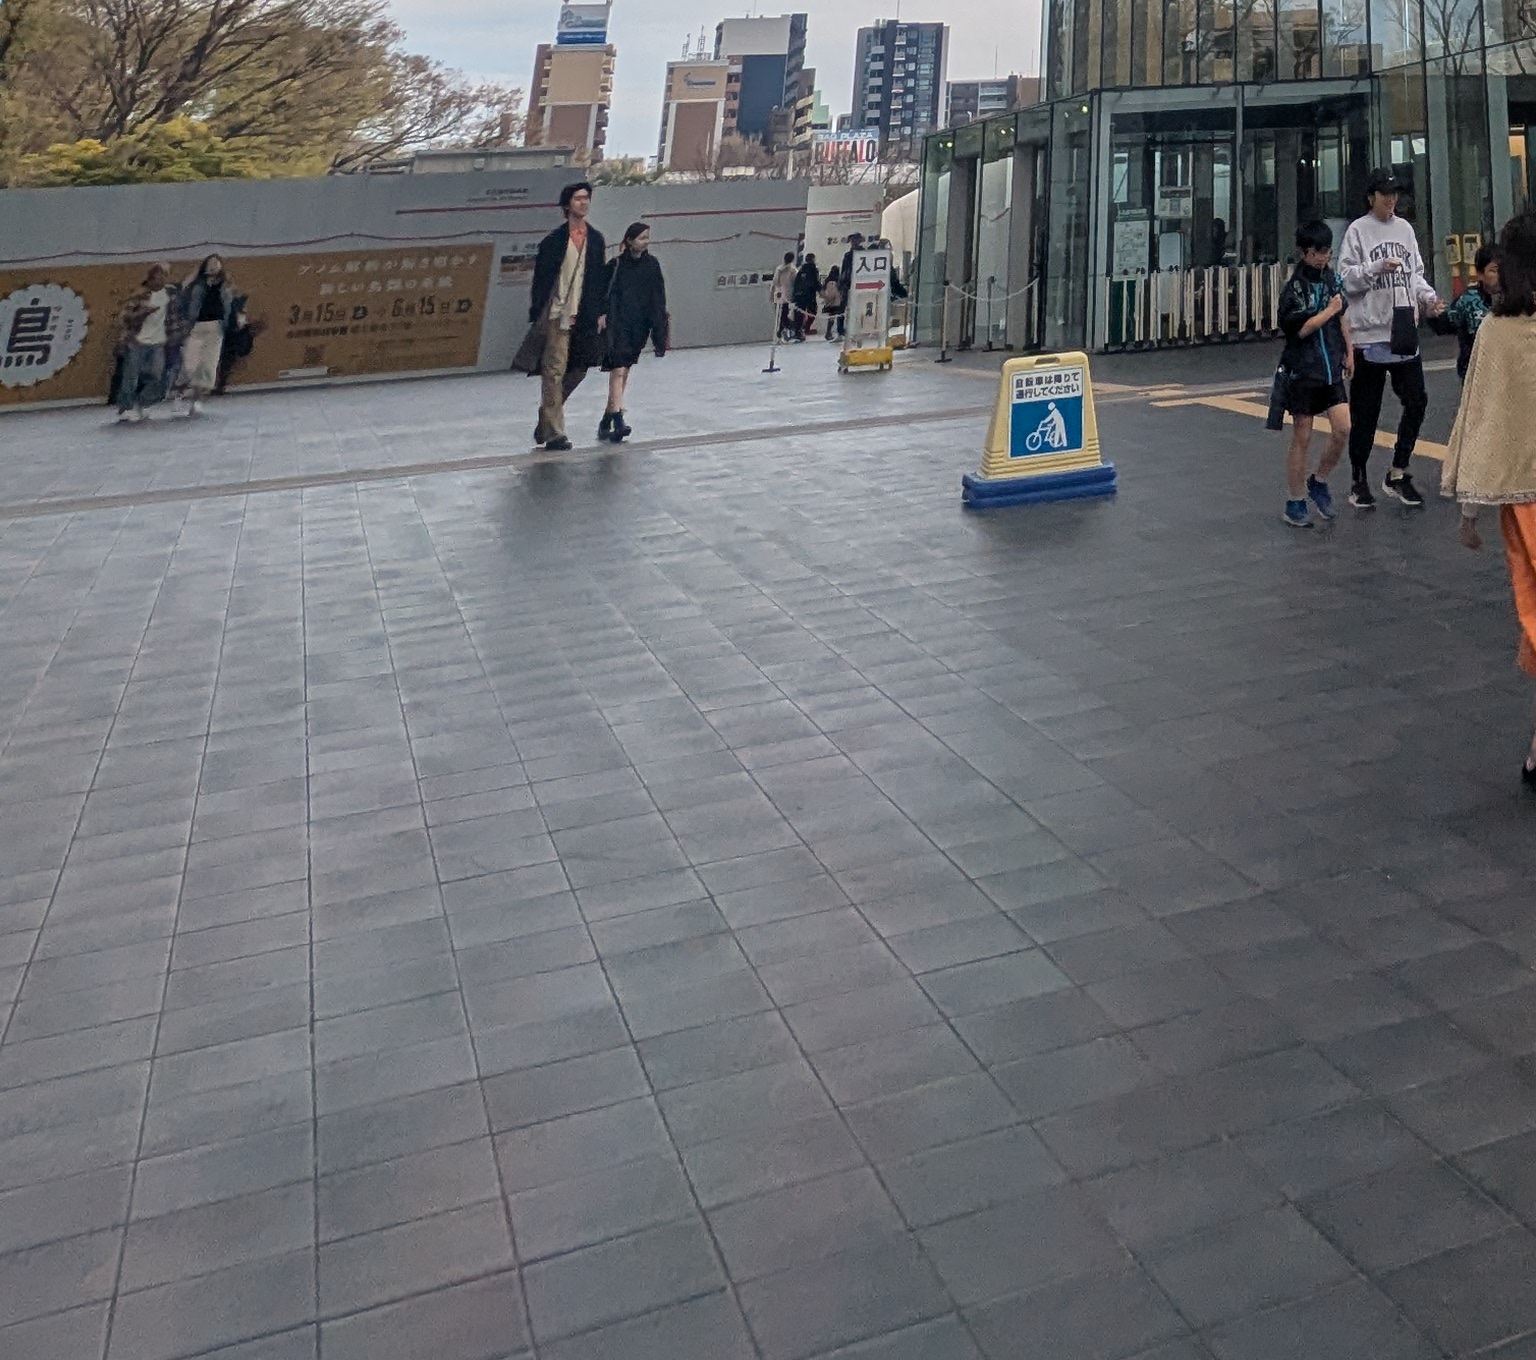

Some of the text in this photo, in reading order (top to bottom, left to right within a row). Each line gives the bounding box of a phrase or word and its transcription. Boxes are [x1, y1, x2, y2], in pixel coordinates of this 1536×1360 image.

[855, 256, 887, 274] 入口
[1015, 371, 1080, 389] 自転車は降りて
